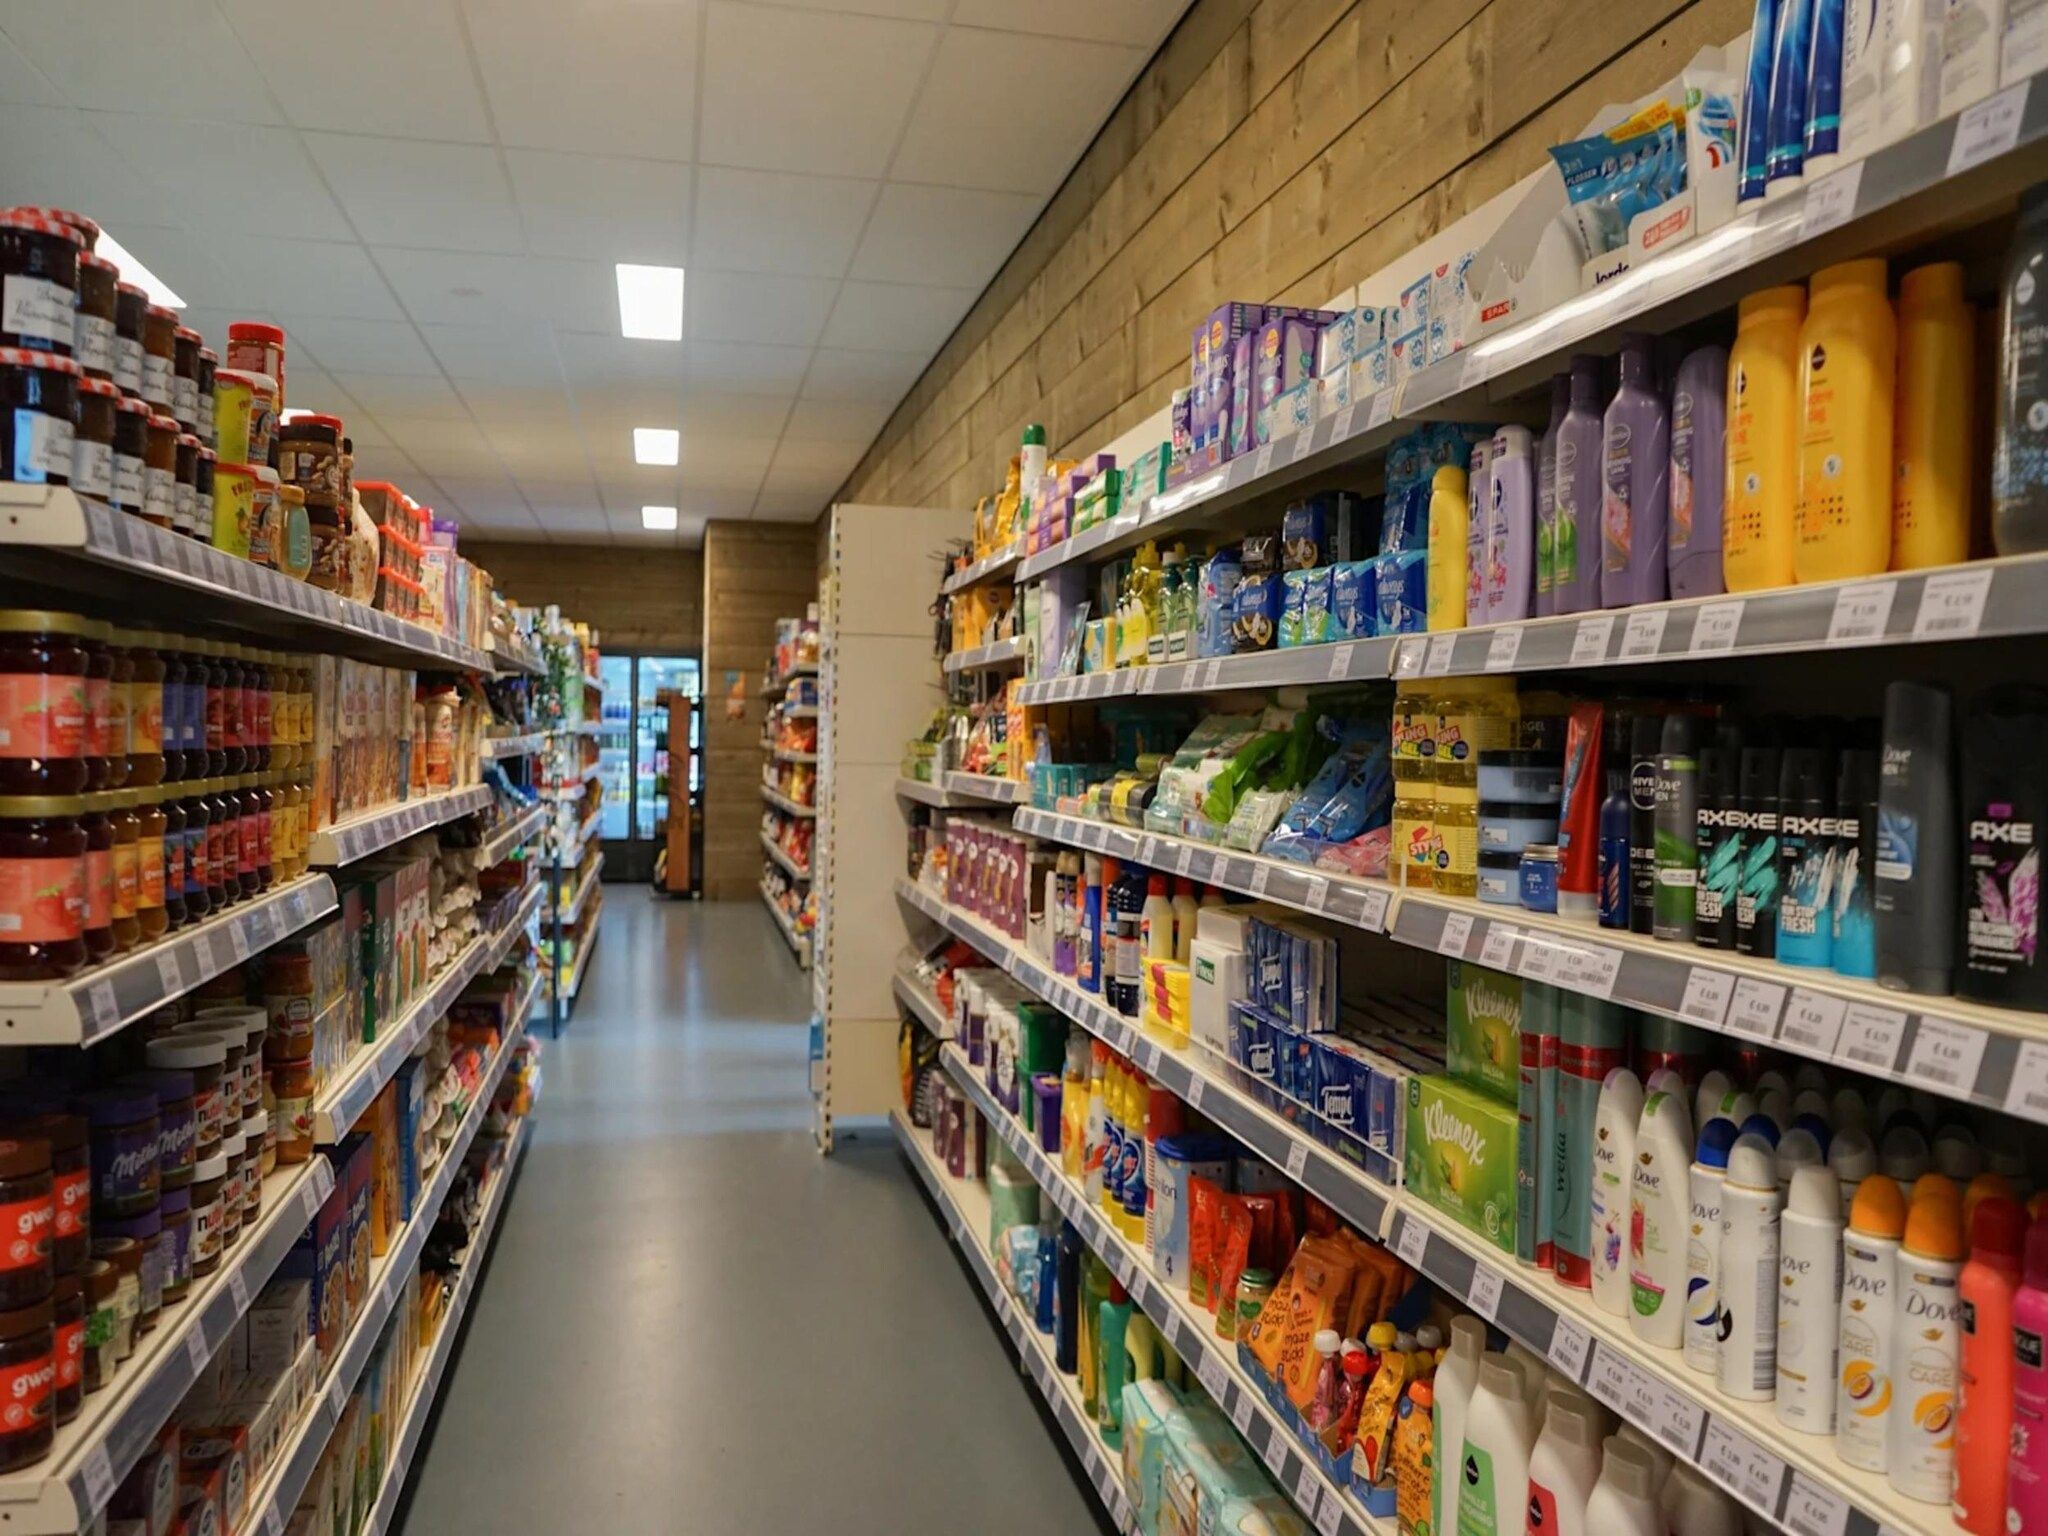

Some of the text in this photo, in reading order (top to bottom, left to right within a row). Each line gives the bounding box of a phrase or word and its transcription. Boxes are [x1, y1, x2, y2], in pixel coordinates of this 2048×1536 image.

[1697, 809, 1742, 827] AXE
[1782, 816, 1838, 836] AXE
[1970, 820, 2033, 844] AXE
[1465, 977, 1522, 1038] Kleenex
[1320, 1084, 1355, 1125] Tempo
[1424, 1099, 1487, 1166] Kleenex
[1633, 1163, 1660, 1189] Dove
[1905, 1290, 1962, 1321] Dove
